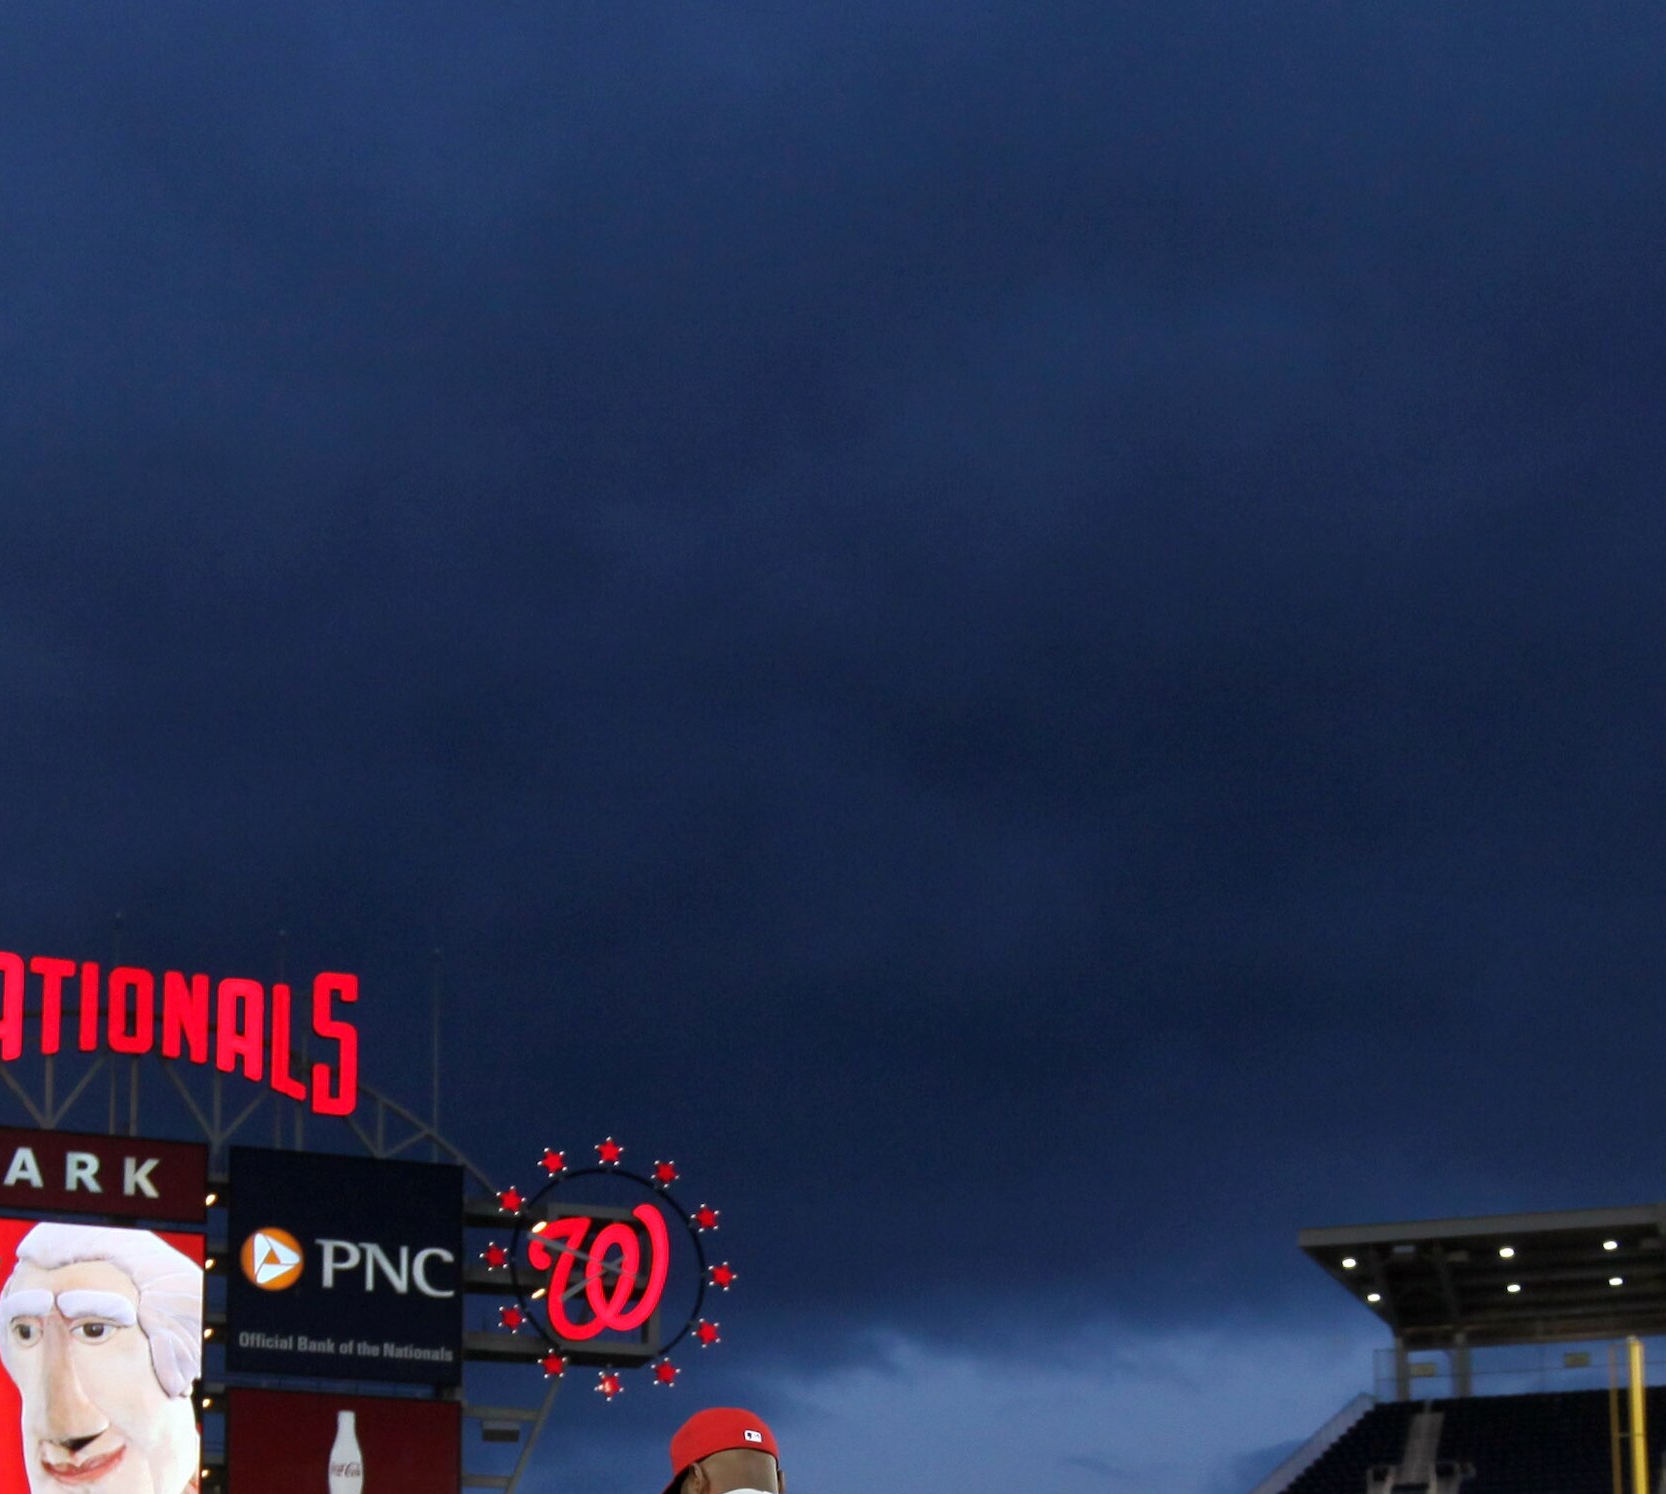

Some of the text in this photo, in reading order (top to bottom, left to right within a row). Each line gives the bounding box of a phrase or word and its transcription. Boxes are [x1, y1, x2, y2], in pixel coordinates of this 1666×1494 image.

[314, 1238, 455, 1298] PNC
[239, 1331, 453, 1362] Official Bank of the Nationals
